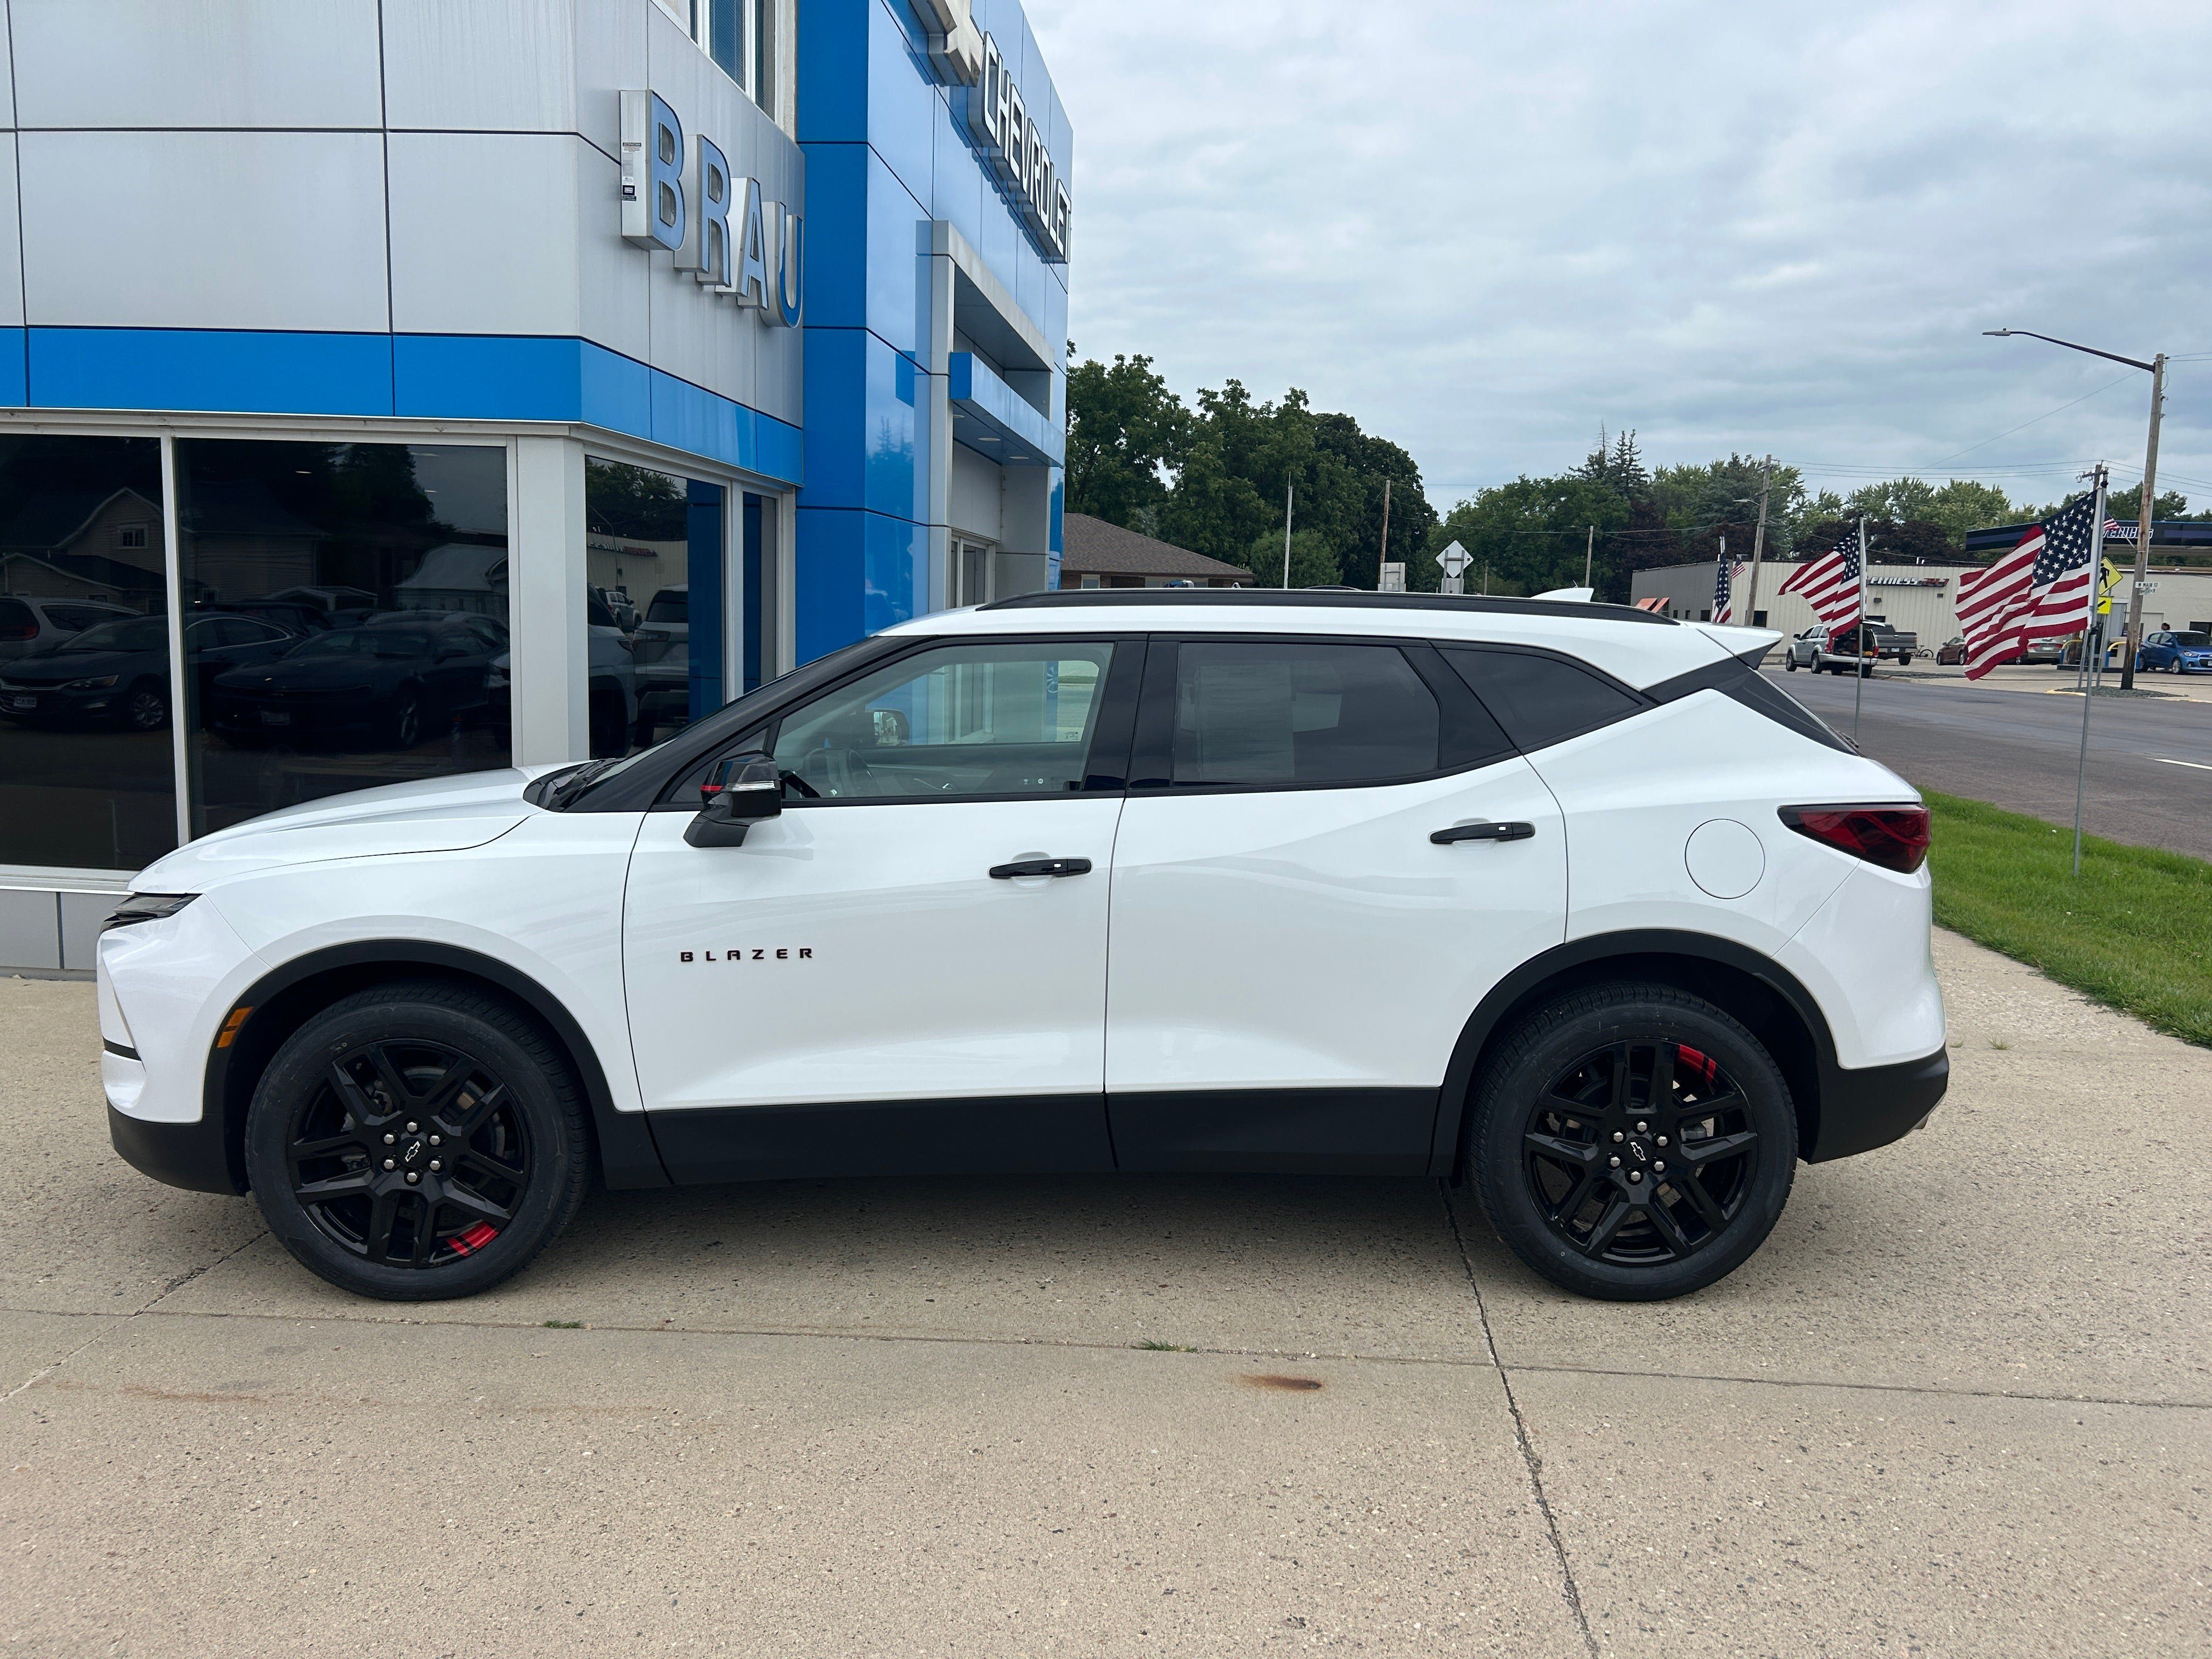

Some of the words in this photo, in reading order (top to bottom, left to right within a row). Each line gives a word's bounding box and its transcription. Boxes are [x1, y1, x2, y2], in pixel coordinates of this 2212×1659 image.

[983, 31, 1071, 263] CHEVROLET
[647, 89, 803, 329] BRAU
[1870, 577, 1918, 585] FITNESS
[680, 948, 813, 962] BLAZER
